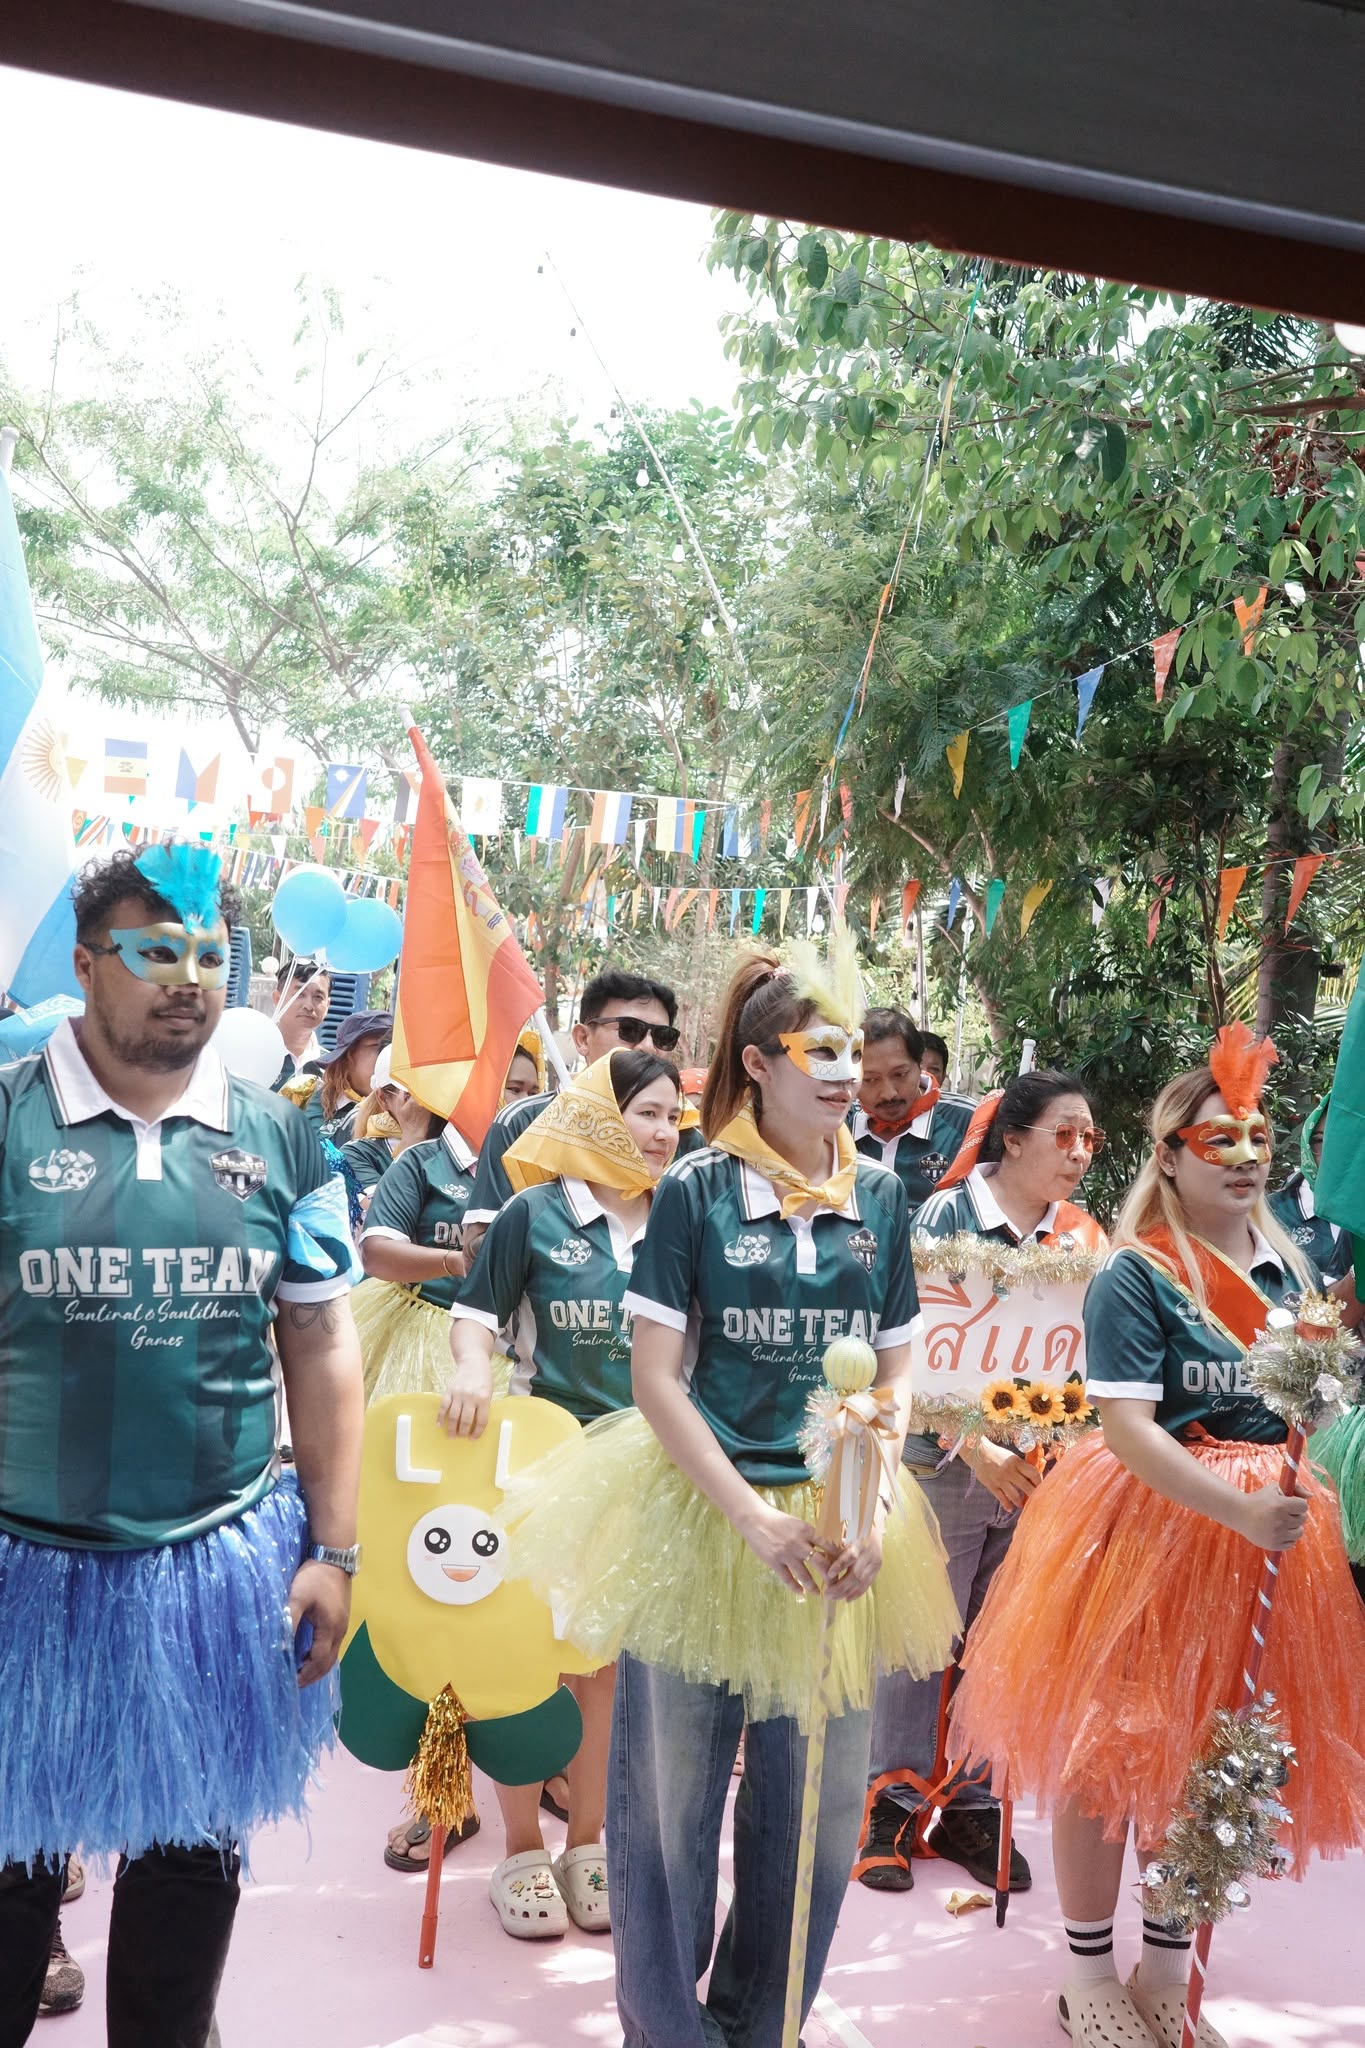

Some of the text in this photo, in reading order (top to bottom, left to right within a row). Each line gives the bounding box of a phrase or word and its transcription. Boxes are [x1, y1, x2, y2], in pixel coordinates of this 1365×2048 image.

[434, 1221, 464, 1247] ON
[19, 1247, 278, 1298] ONE TEAM
[549, 1299, 613, 1332] ONE
[722, 1306, 795, 1346] ONE
[916, 1282, 1082, 1374] สีแด
[130, 1325, 184, 1349] Games
[788, 1366, 824, 1384] Games
[1182, 1360, 1257, 1397] ONE
